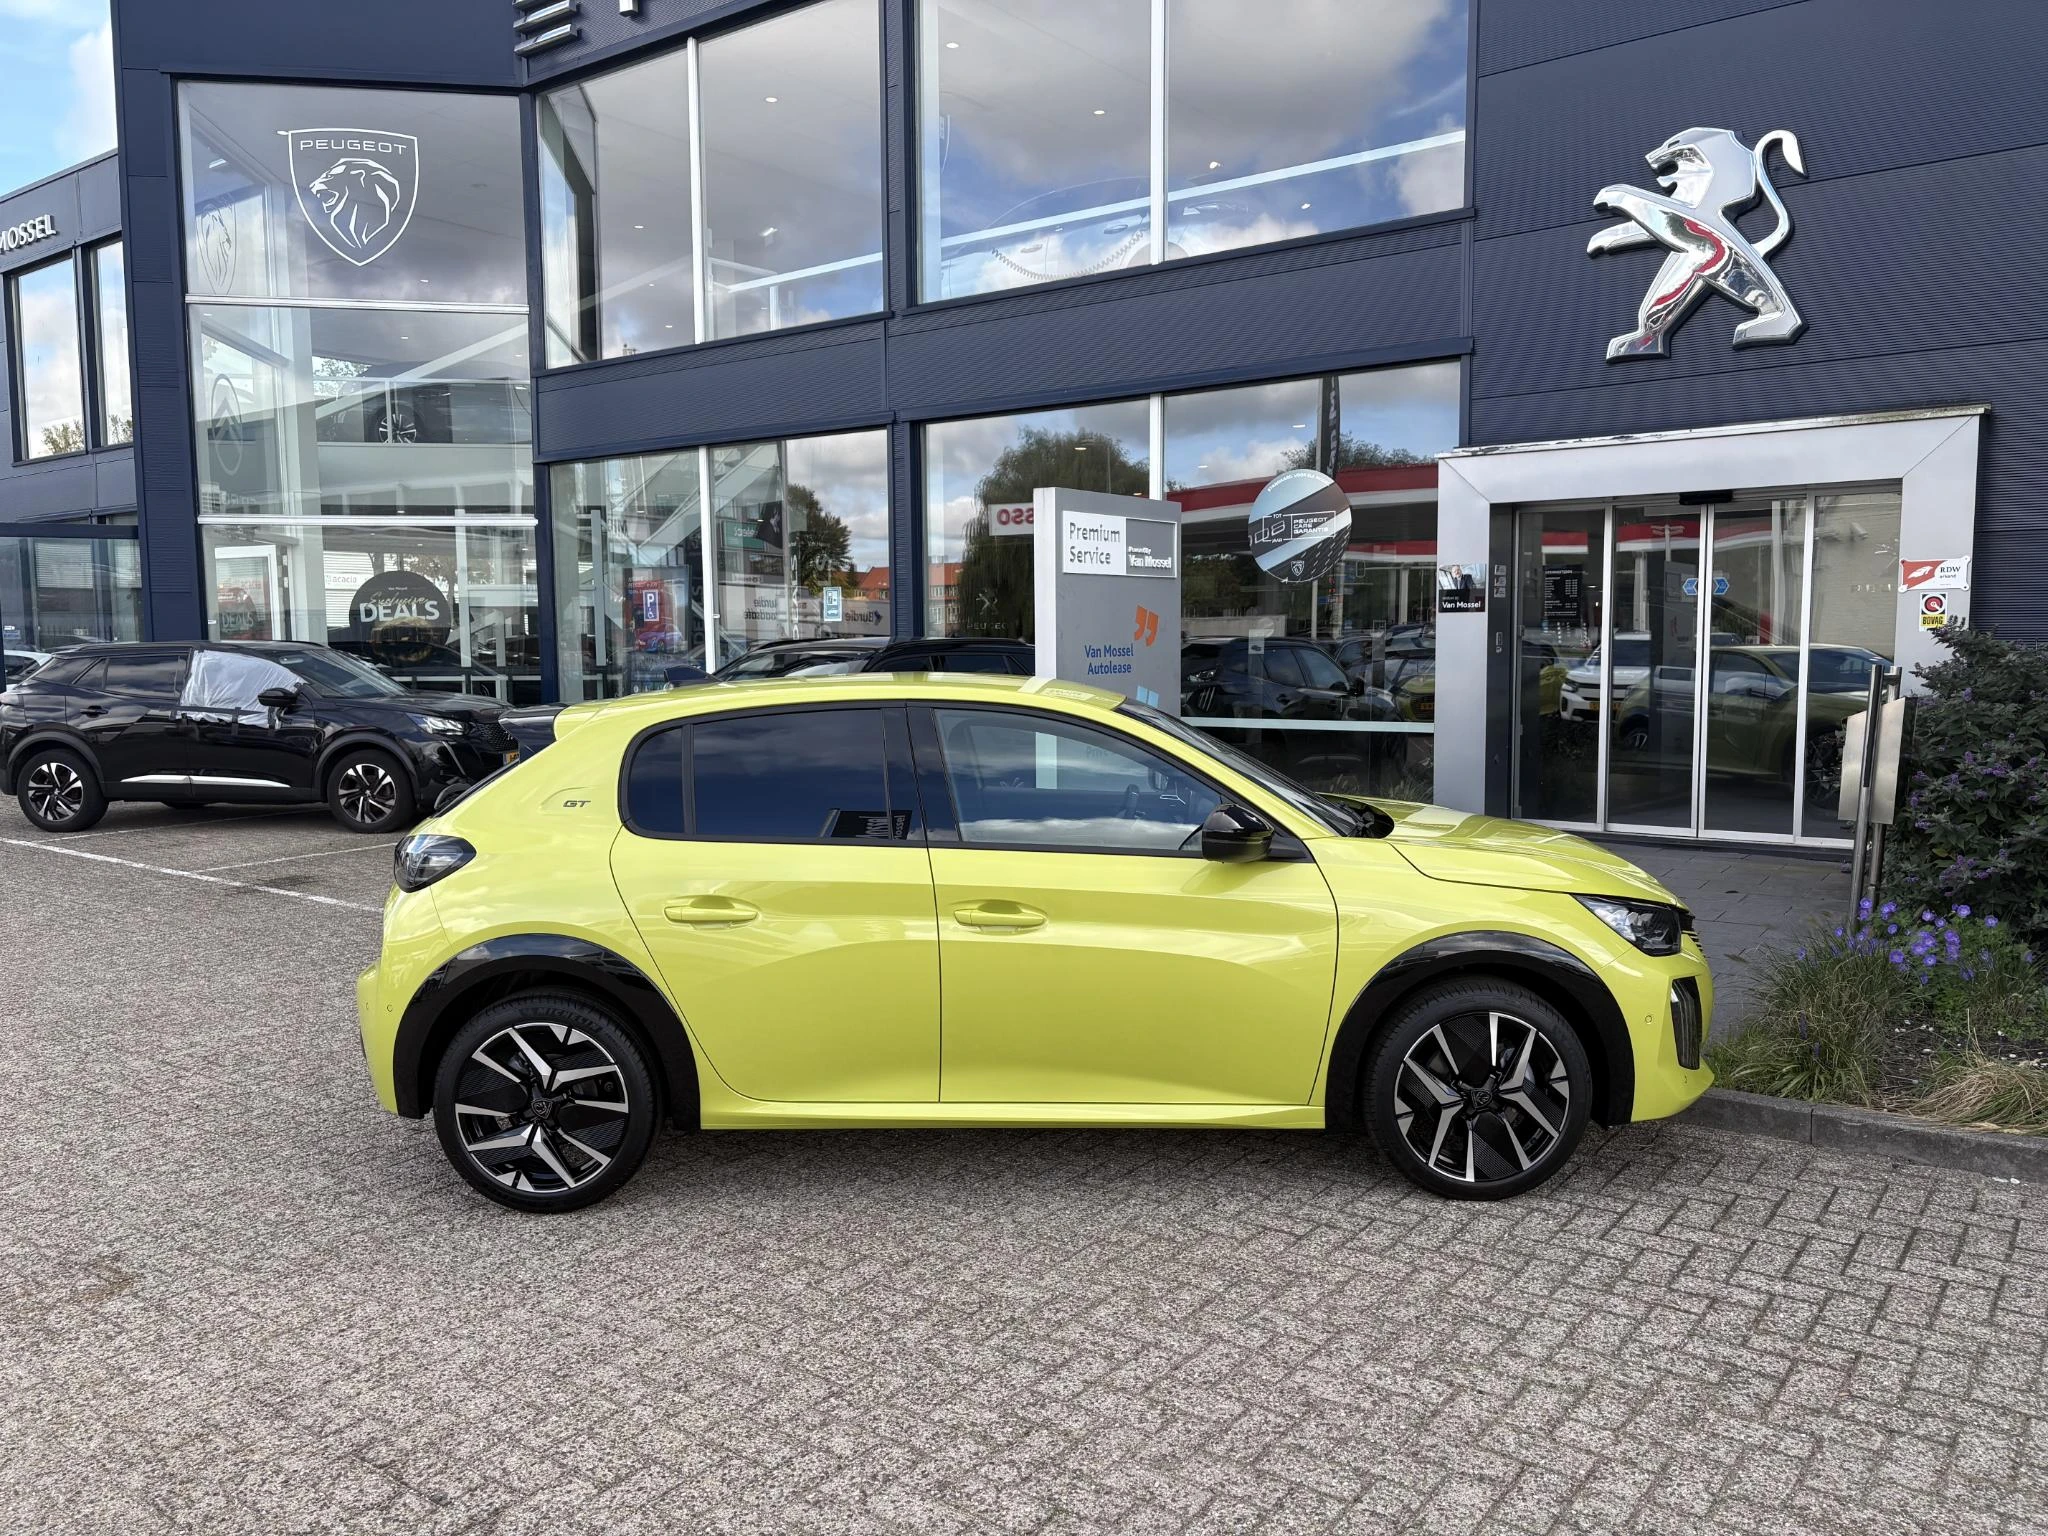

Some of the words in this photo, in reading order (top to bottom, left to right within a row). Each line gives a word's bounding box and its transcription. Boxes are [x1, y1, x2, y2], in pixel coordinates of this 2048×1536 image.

[300, 139, 407, 155] PEUGEOT
[1069, 521, 1120, 543] Premium
[1069, 545, 1111, 565] Service
[1128, 554, 1144, 567] Van
[1144, 555, 1172, 569] Mossel
[1940, 566, 1961, 574] RDW
[359, 600, 440, 623] DEALS
[1442, 601, 1456, 609] Van
[1456, 600, 1481, 608] Mossel
[1922, 616, 1944, 625] BOVAG
[1084, 645, 1101, 658] Van
[1104, 643, 1134, 658] Mossel
[1088, 661, 1132, 675] Autolease
[563, 800, 591, 808] GT
